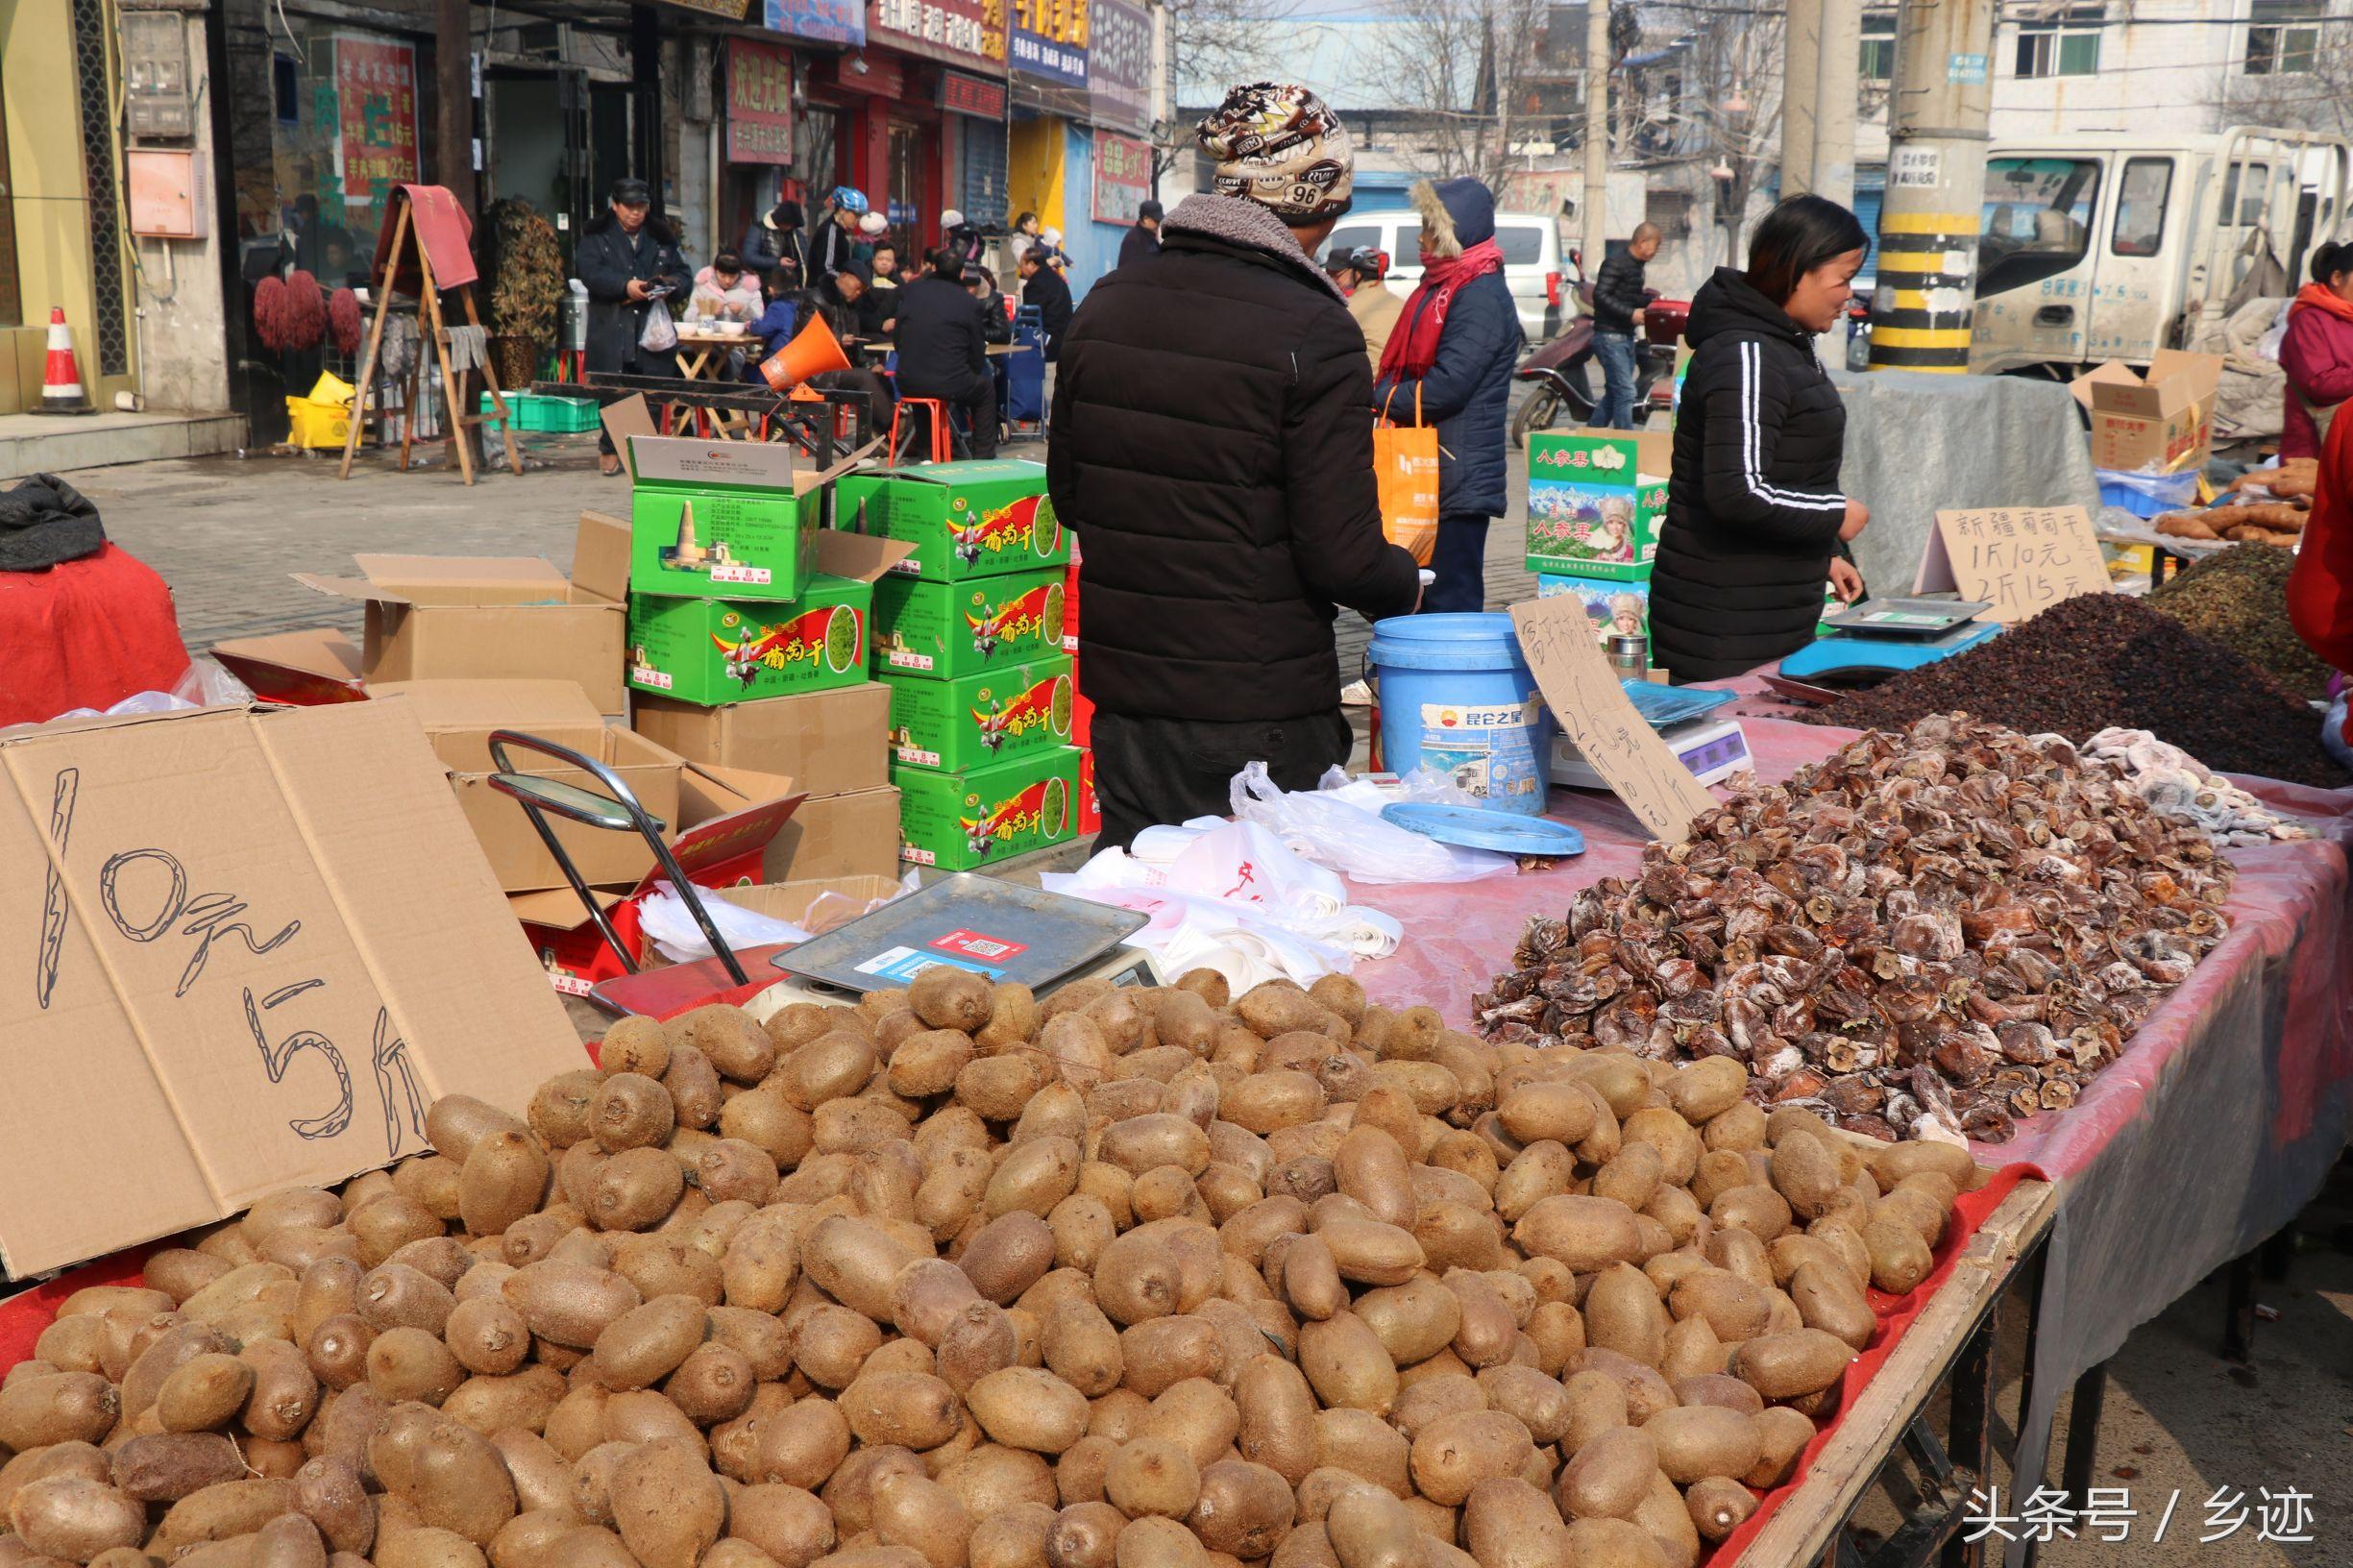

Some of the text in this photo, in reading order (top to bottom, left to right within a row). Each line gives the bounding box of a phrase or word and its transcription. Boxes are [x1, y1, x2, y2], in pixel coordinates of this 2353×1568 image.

[1292, 185, 1317, 205] 96
[1537, 449, 1589, 468] 人参果
[981, 521, 1034, 552] 葡萄干
[1533, 520, 1592, 541] 人参果
[1956, 511, 2078, 538] 新疆葡萄干
[998, 612, 1043, 643] 葡萄干
[757, 637, 825, 671] 葡萄干
[1005, 705, 1052, 737] 葡萄干
[1466, 710, 1523, 726] 昆仑之星
[993, 810, 1042, 841] 葡萄干
[37, 767, 302, 1009] 10元
